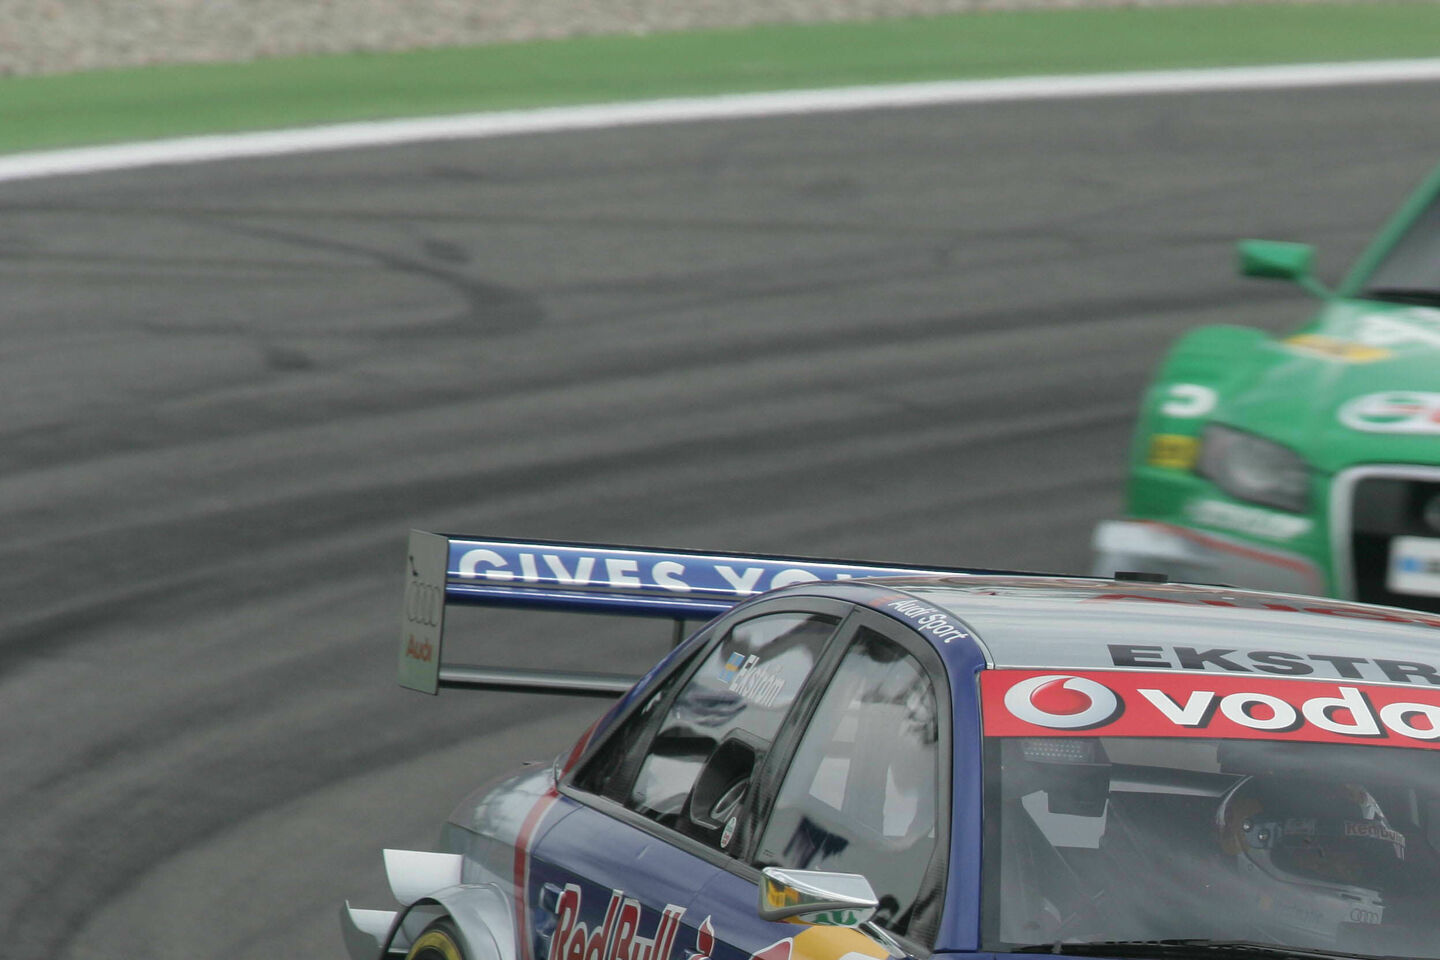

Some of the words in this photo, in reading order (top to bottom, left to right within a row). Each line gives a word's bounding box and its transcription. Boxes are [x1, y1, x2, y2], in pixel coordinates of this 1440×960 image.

[458, 548, 692, 594] GIVES
[888, 599, 937, 618] Audi
[918, 613, 968, 643] Sport
